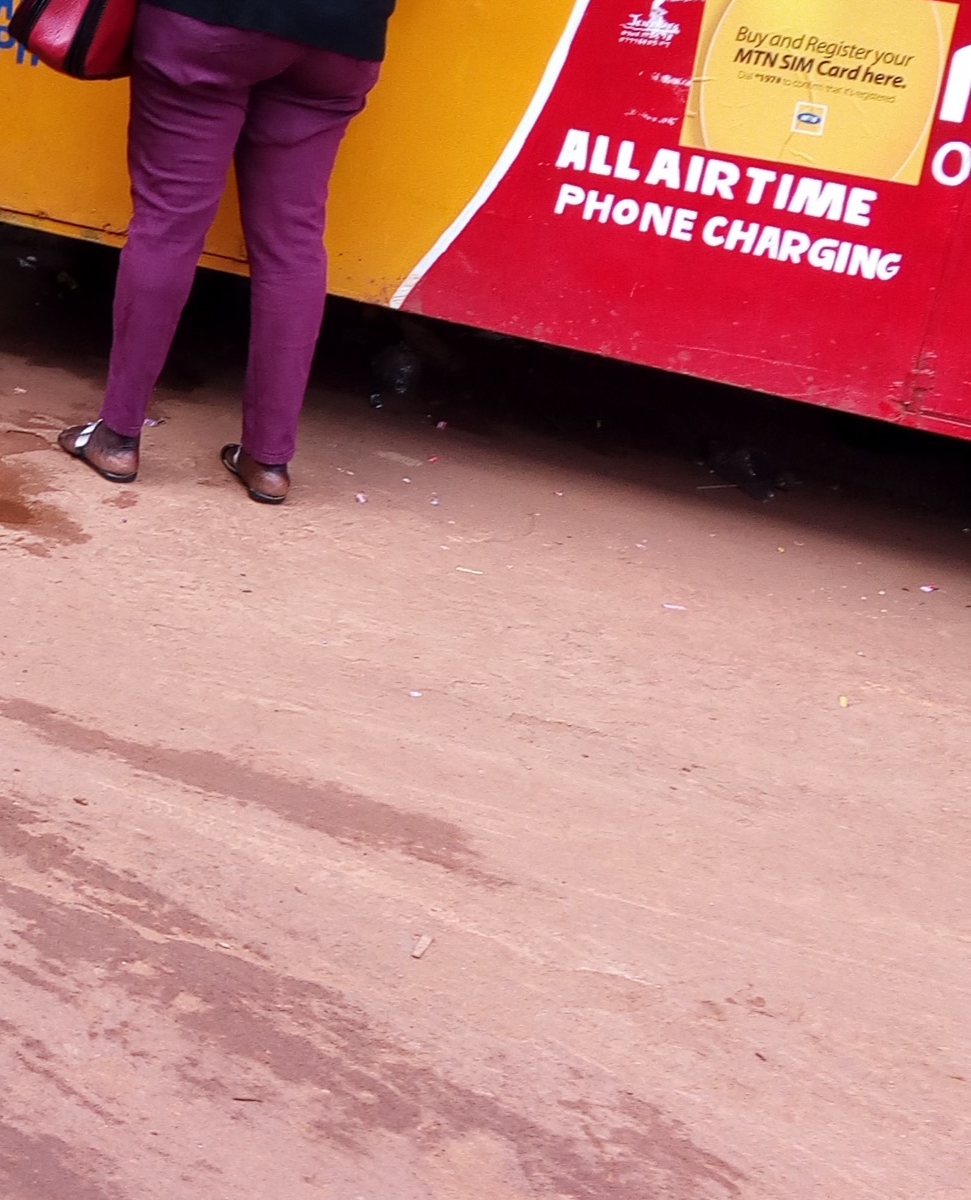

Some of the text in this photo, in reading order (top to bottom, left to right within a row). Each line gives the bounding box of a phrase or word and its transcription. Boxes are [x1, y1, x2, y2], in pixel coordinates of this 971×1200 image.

[733, 48, 907, 89] MTN SIM Card here.
[735, 26, 915, 67] Buy and Register your
[555, 128, 640, 181] ALL
[553, 183, 902, 281] PHONE CHARGING
